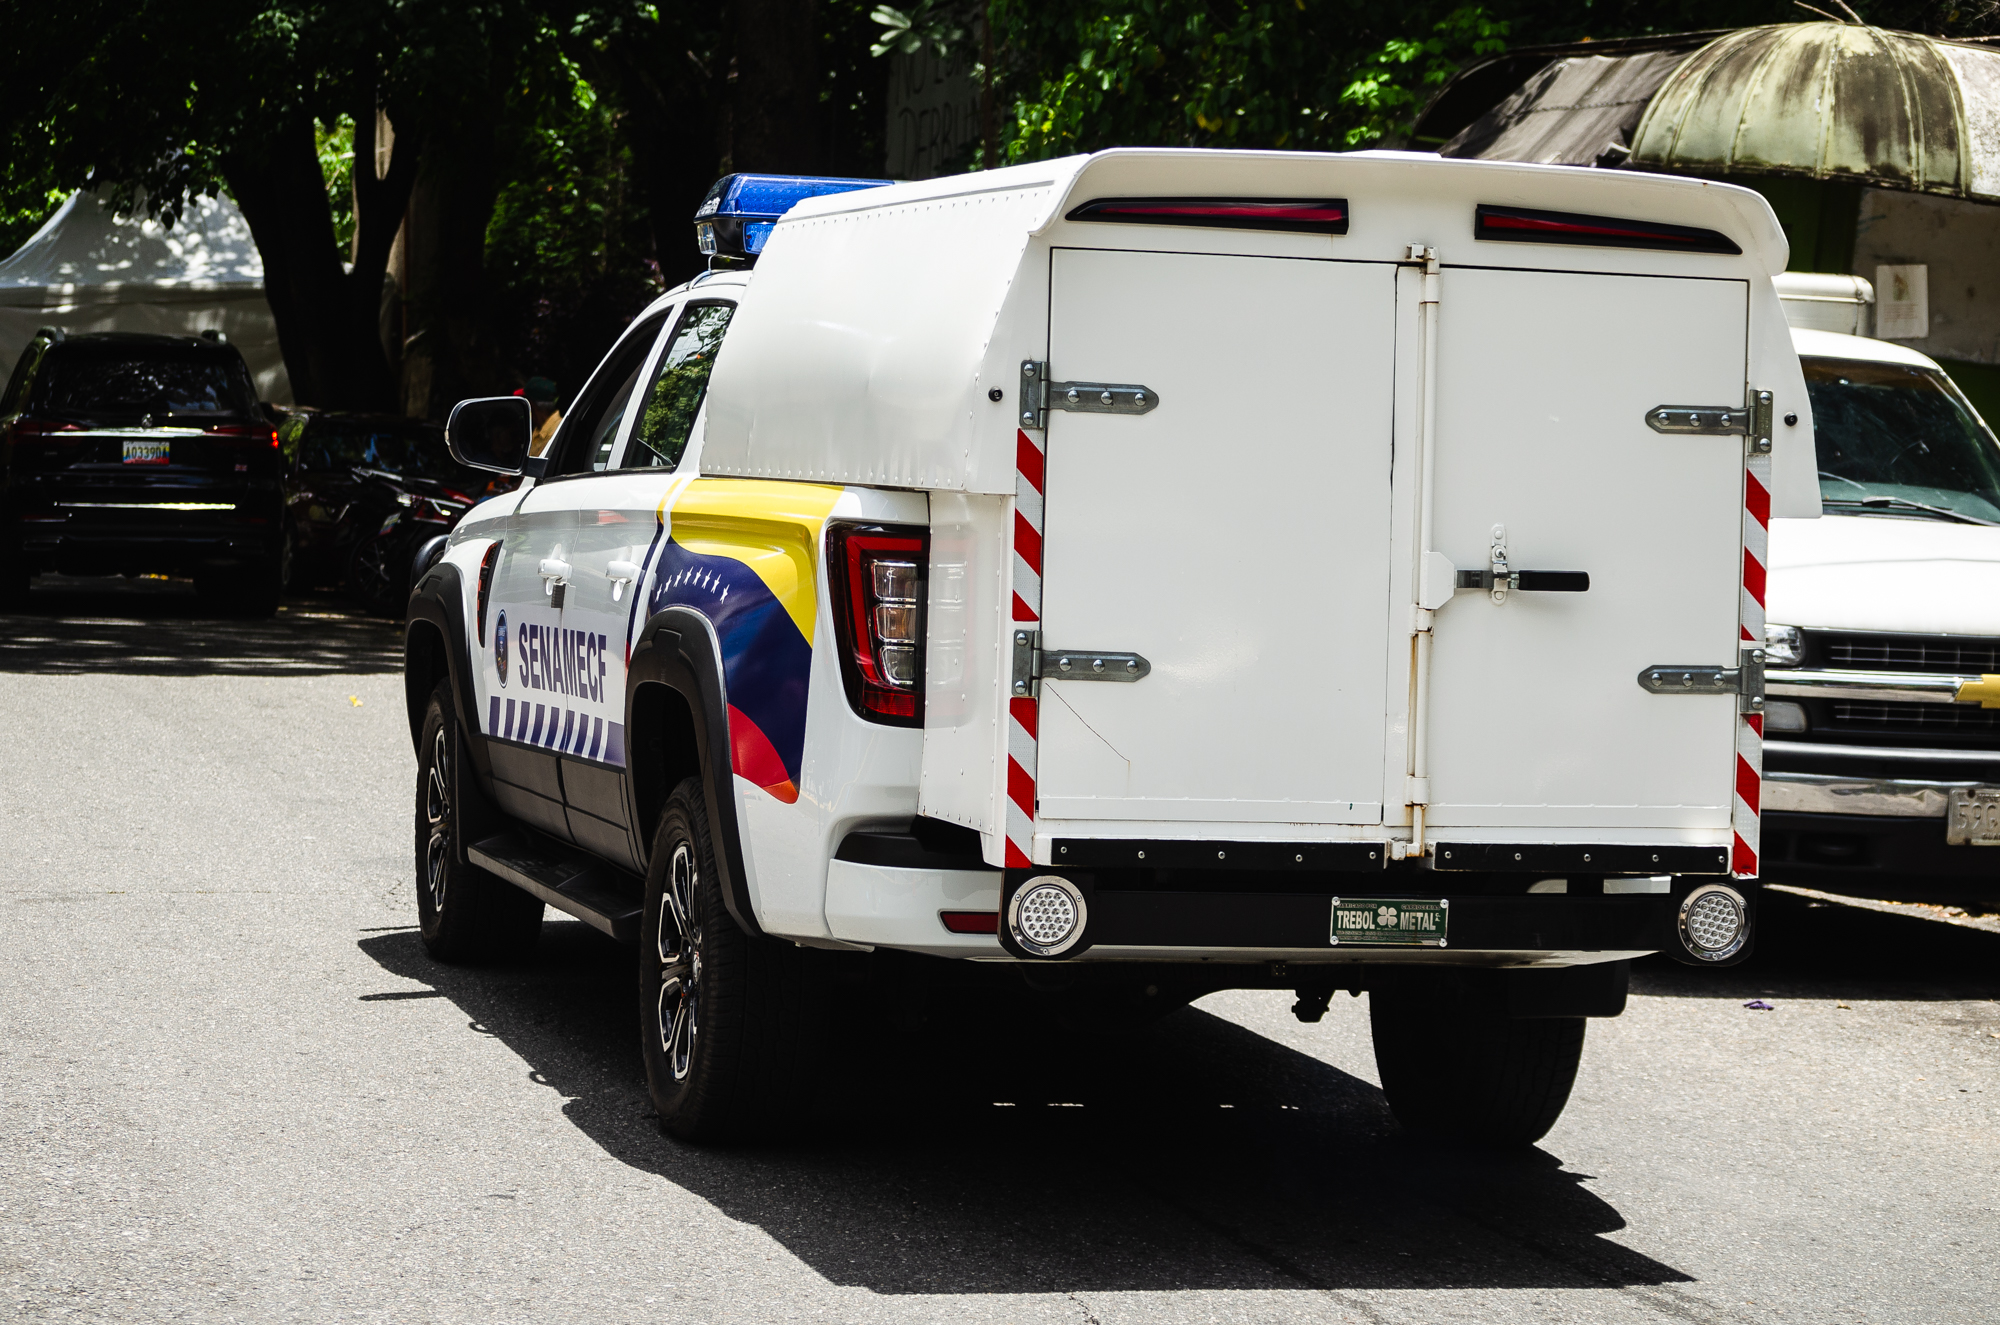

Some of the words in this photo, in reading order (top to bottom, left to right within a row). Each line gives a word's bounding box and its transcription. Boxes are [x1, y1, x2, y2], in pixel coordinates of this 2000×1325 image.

[518, 622, 607, 703] SENAMECF
[1336, 910, 1375, 930] TREBOL
[1400, 911, 1436, 931] METAL
